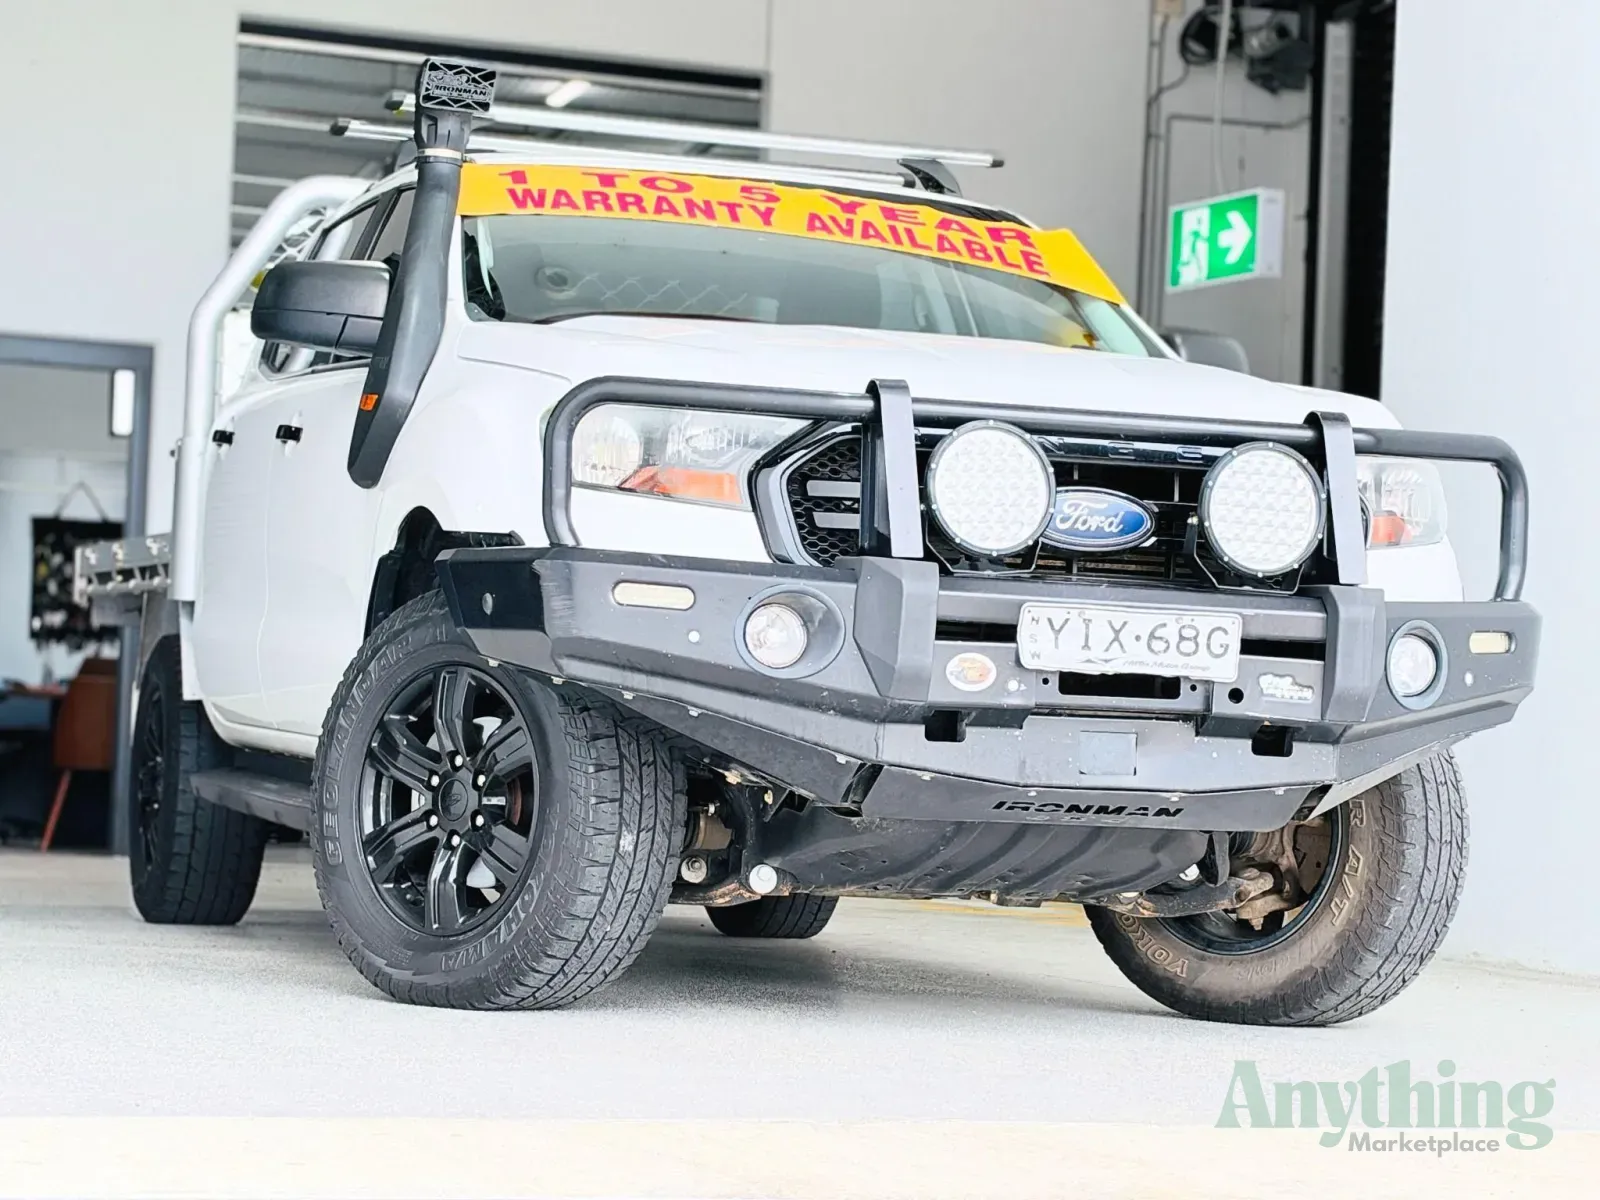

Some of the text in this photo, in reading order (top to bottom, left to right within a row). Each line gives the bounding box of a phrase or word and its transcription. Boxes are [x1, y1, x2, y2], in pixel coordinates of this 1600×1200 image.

[434, 85, 487, 96] IRONMAN
[498, 170, 1038, 249] 1 TO 5 YEAR
[505, 188, 1051, 278] WARRANTY AVAILABLE
[1055, 499, 1124, 534] Ford
[992, 800, 1184, 818] IRONMAN
